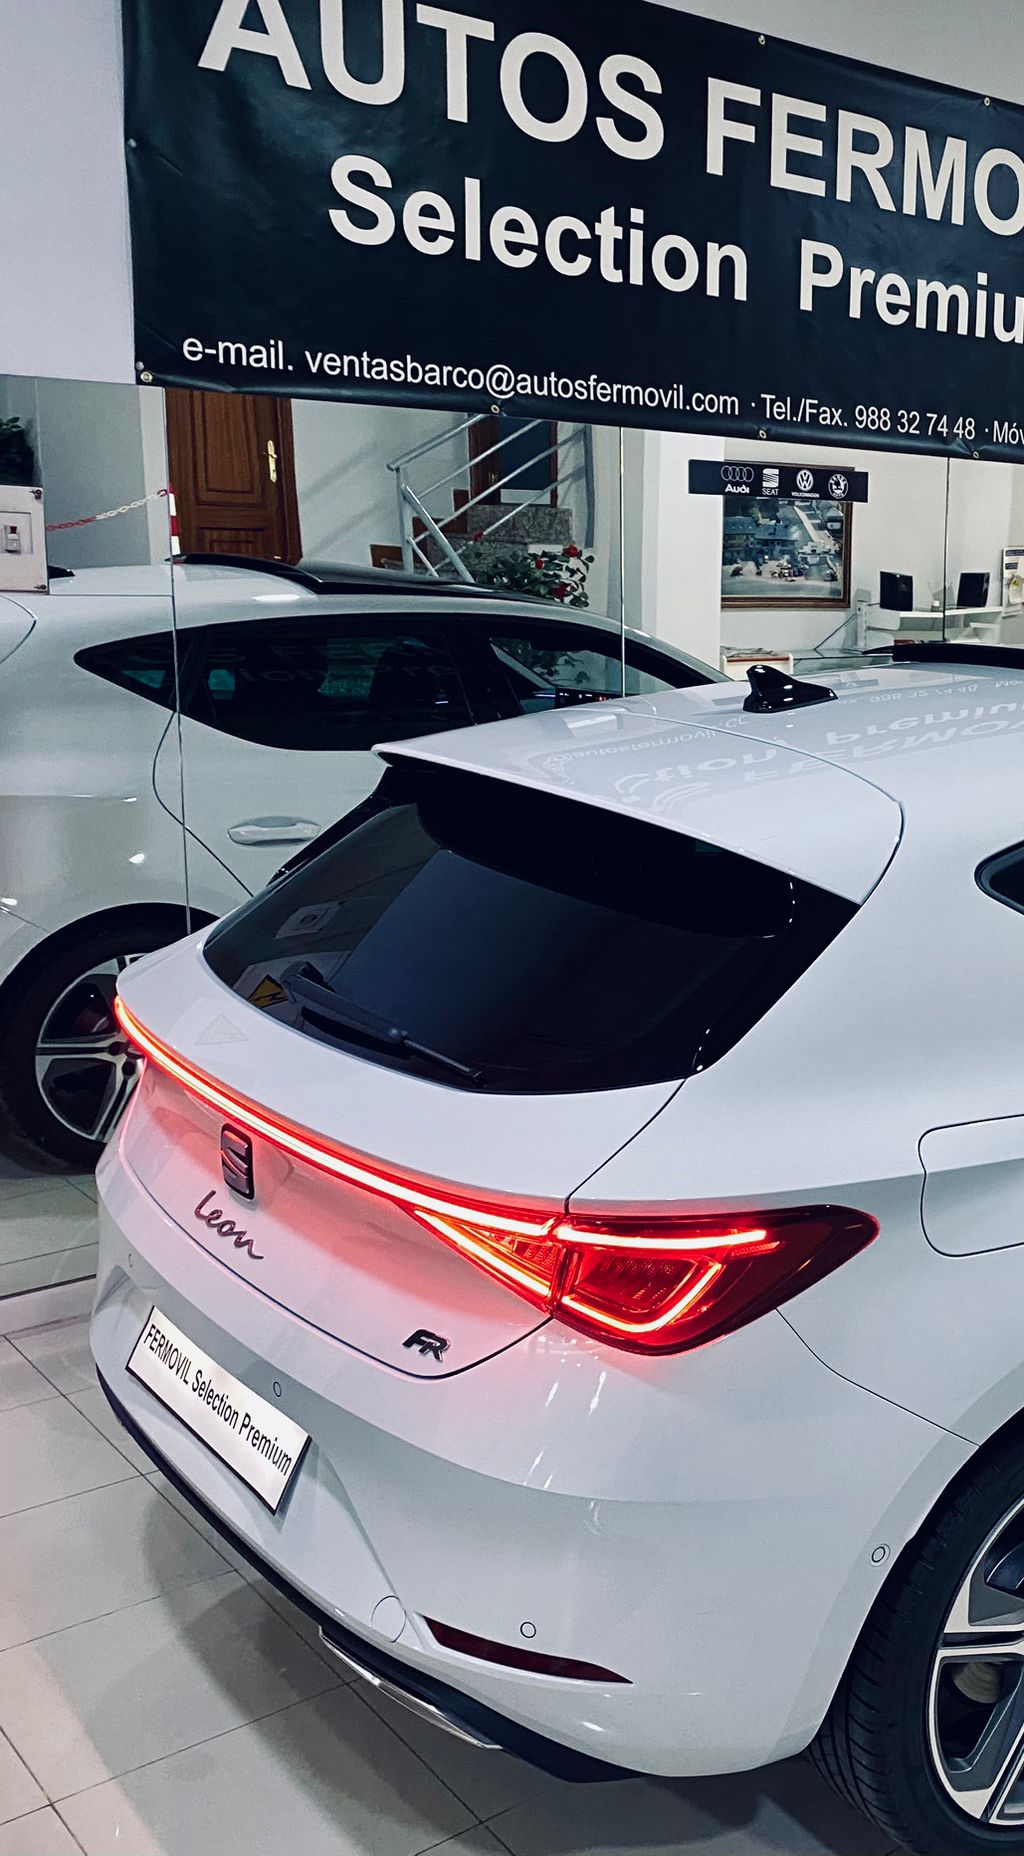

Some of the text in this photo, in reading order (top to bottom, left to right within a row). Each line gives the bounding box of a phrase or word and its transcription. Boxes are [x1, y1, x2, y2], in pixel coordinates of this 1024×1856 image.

[198, 0, 665, 161] AUTOS
[328, 154, 748, 302] Selection
[182, 337, 294, 371] e-mail.
[304, 350, 739, 416] ventasbarco@autosfermovil.com
[760, 393, 848, 427] Tel./Fax.
[854, 404, 891, 432] 988
[896, 409, 920, 435] 32
[926, 412, 949, 437] 74
[952, 416, 976, 440] 48
[724, 483, 750, 494] Audi
[762, 488, 780, 496] SEAT
[194, 1189, 265, 1260] Leon
[402, 1328, 451, 1363] FR
[143, 1323, 293, 1477] FERMOVIL Selection Premium
